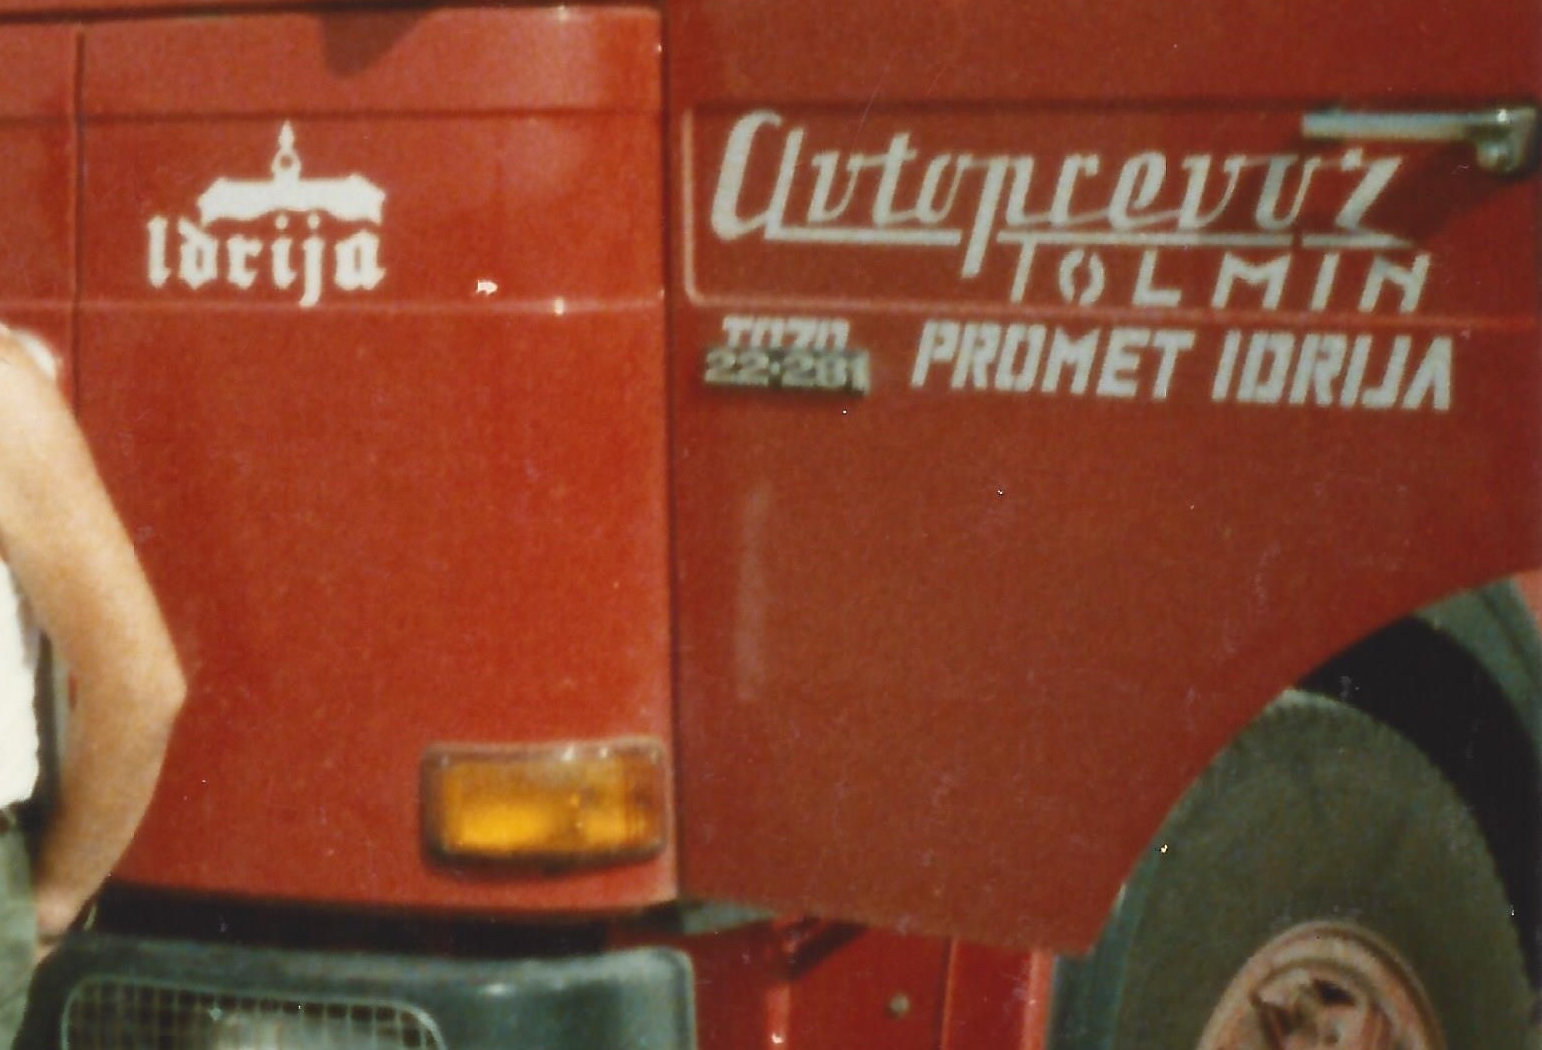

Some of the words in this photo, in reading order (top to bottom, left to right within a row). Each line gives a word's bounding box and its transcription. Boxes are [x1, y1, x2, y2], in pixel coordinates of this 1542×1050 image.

[147, 213, 386, 308] Idrija
[1010, 239, 1431, 313] TOLMIN
[911, 318, 1198, 400] PROMET
[1210, 328, 1453, 411] IDRIJA
